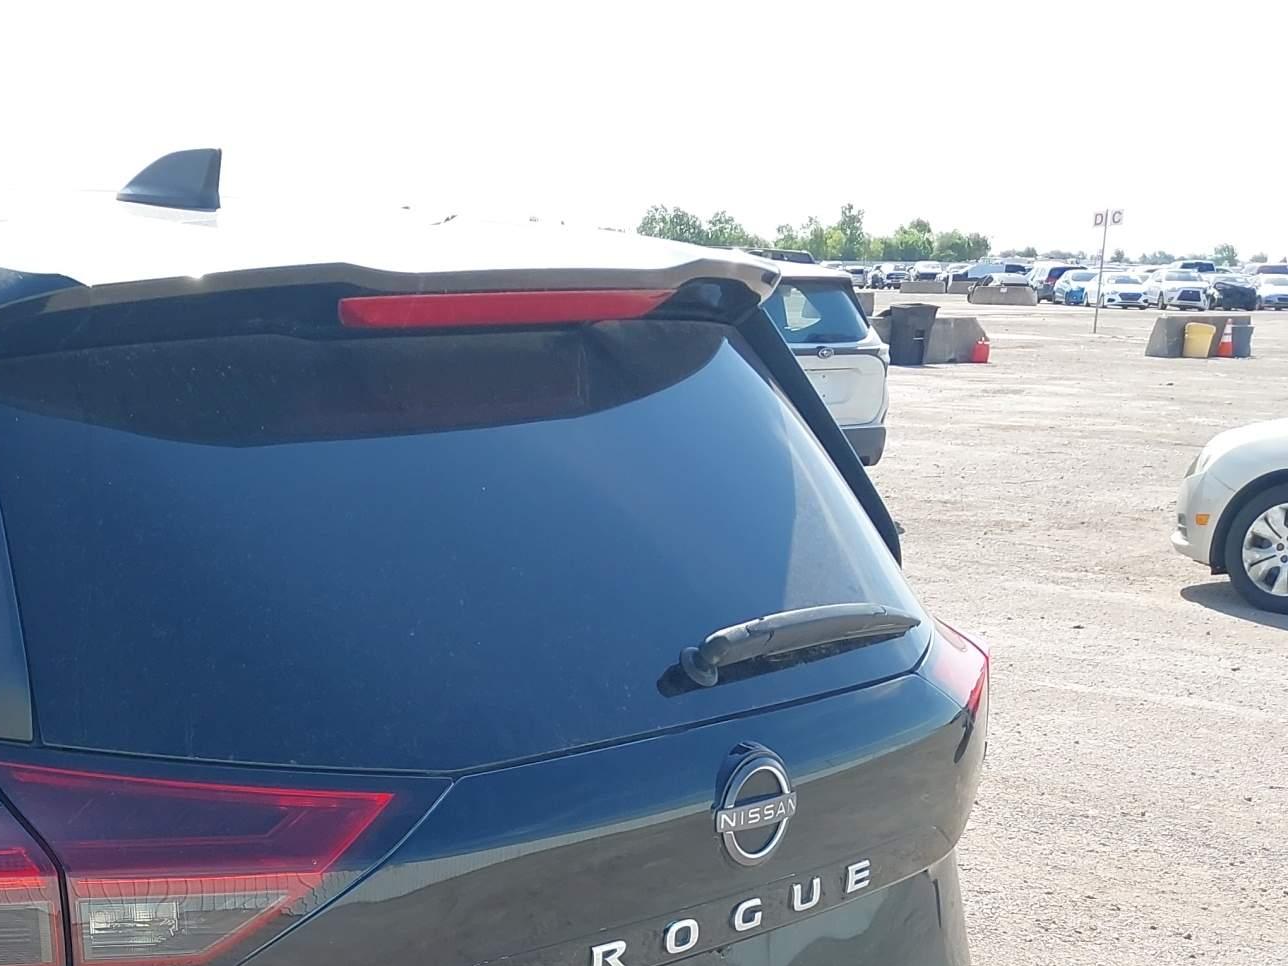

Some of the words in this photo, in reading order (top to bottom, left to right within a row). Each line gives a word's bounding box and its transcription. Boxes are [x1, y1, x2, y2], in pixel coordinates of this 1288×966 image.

[1094, 213, 1104, 226] D
[1112, 210, 1123, 224] C
[720, 797, 797, 829] NISSAN
